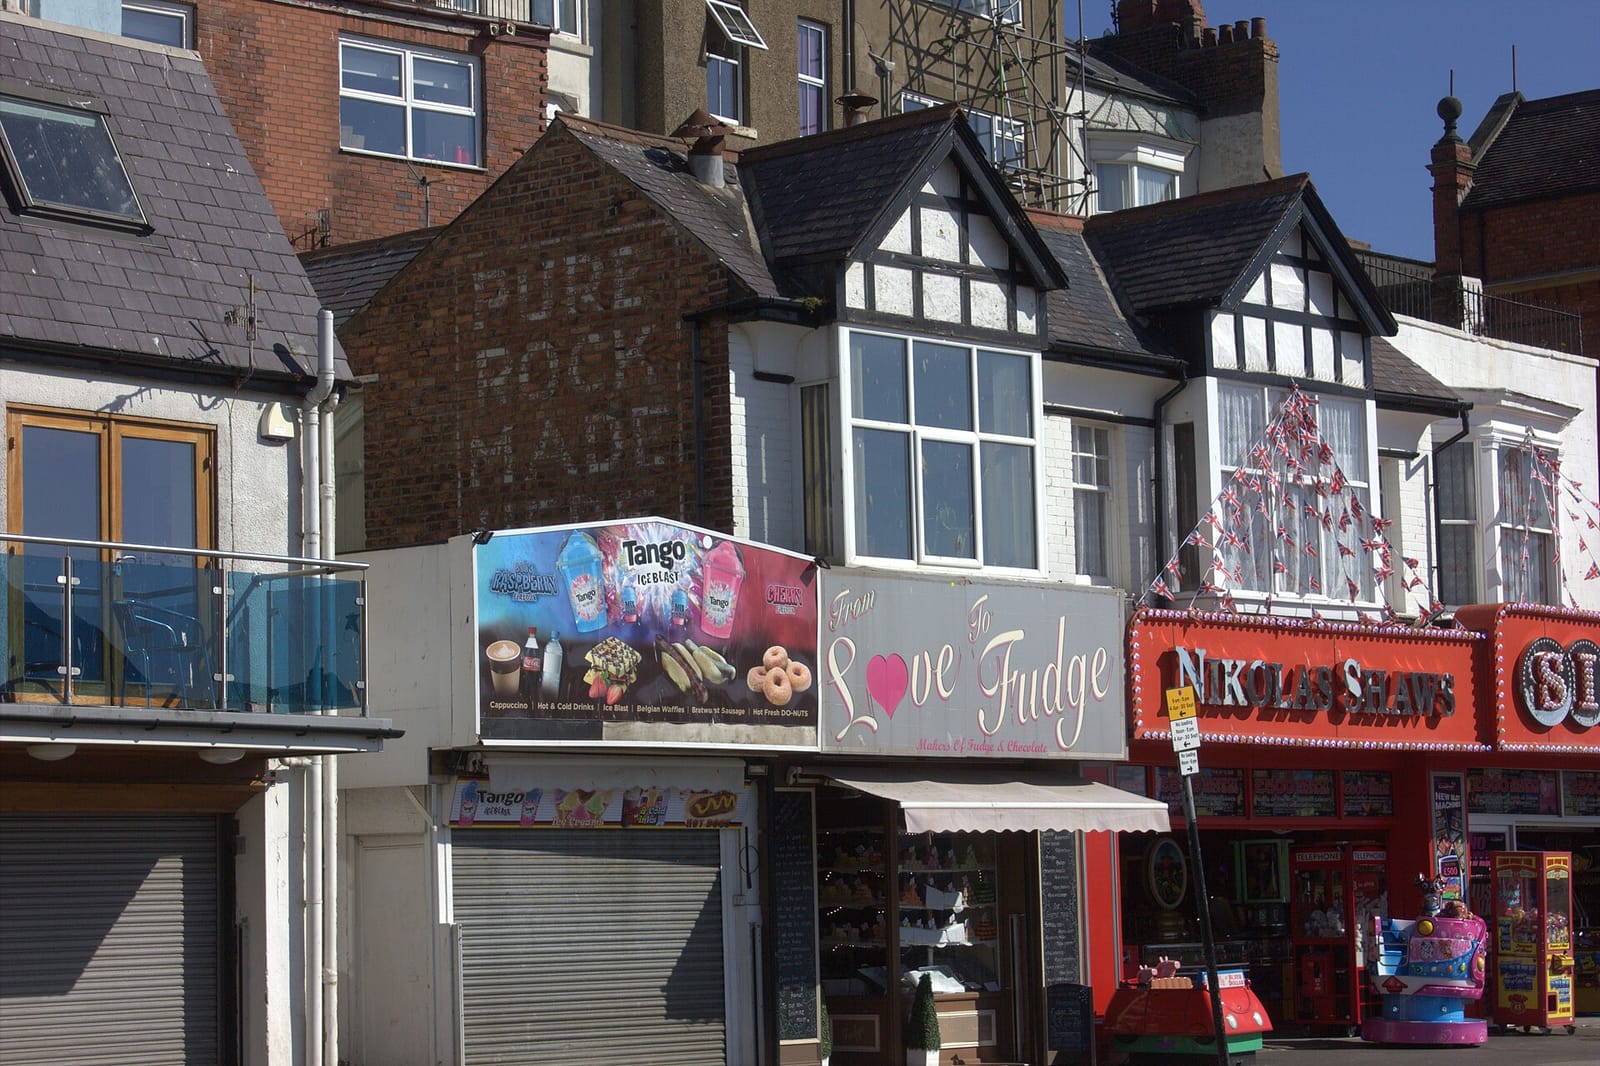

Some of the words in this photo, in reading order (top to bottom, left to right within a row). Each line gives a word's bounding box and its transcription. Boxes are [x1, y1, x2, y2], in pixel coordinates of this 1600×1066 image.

[622, 540, 686, 570] Tango
[492, 572, 559, 594] RASPBERRY
[577, 590, 597, 603] Tango
[709, 597, 730, 609] Tango
[767, 586, 804, 606] CHERRY
[828, 589, 875, 633] From
[967, 594, 992, 645] To
[977, 615, 1114, 751] Fudge
[1175, 645, 1333, 711] NIKOLAS
[1343, 658, 1456, 717] SHAWS
[490, 701, 528, 711] Cappuccino
[557, 702, 572, 710] Cold
[573, 703, 594, 711] Drinks
[614, 705, 628, 713] Blast
[637, 706, 661, 715] Belgian
[662, 706, 685, 714] Waffles
[692, 707, 721, 715] Bratwust
[721, 707, 745, 716] Sausage
[764, 709, 780, 717] Fresh
[781, 709, 808, 718] DO-NUTS
[917, 738, 951, 752] Makers
[951, 738, 966, 753] Of
[968, 739, 993, 753] Fudge
[997, 740, 1004, 752] &
[1007, 740, 1048, 753] Chocolate
[477, 790, 525, 806] Tango
